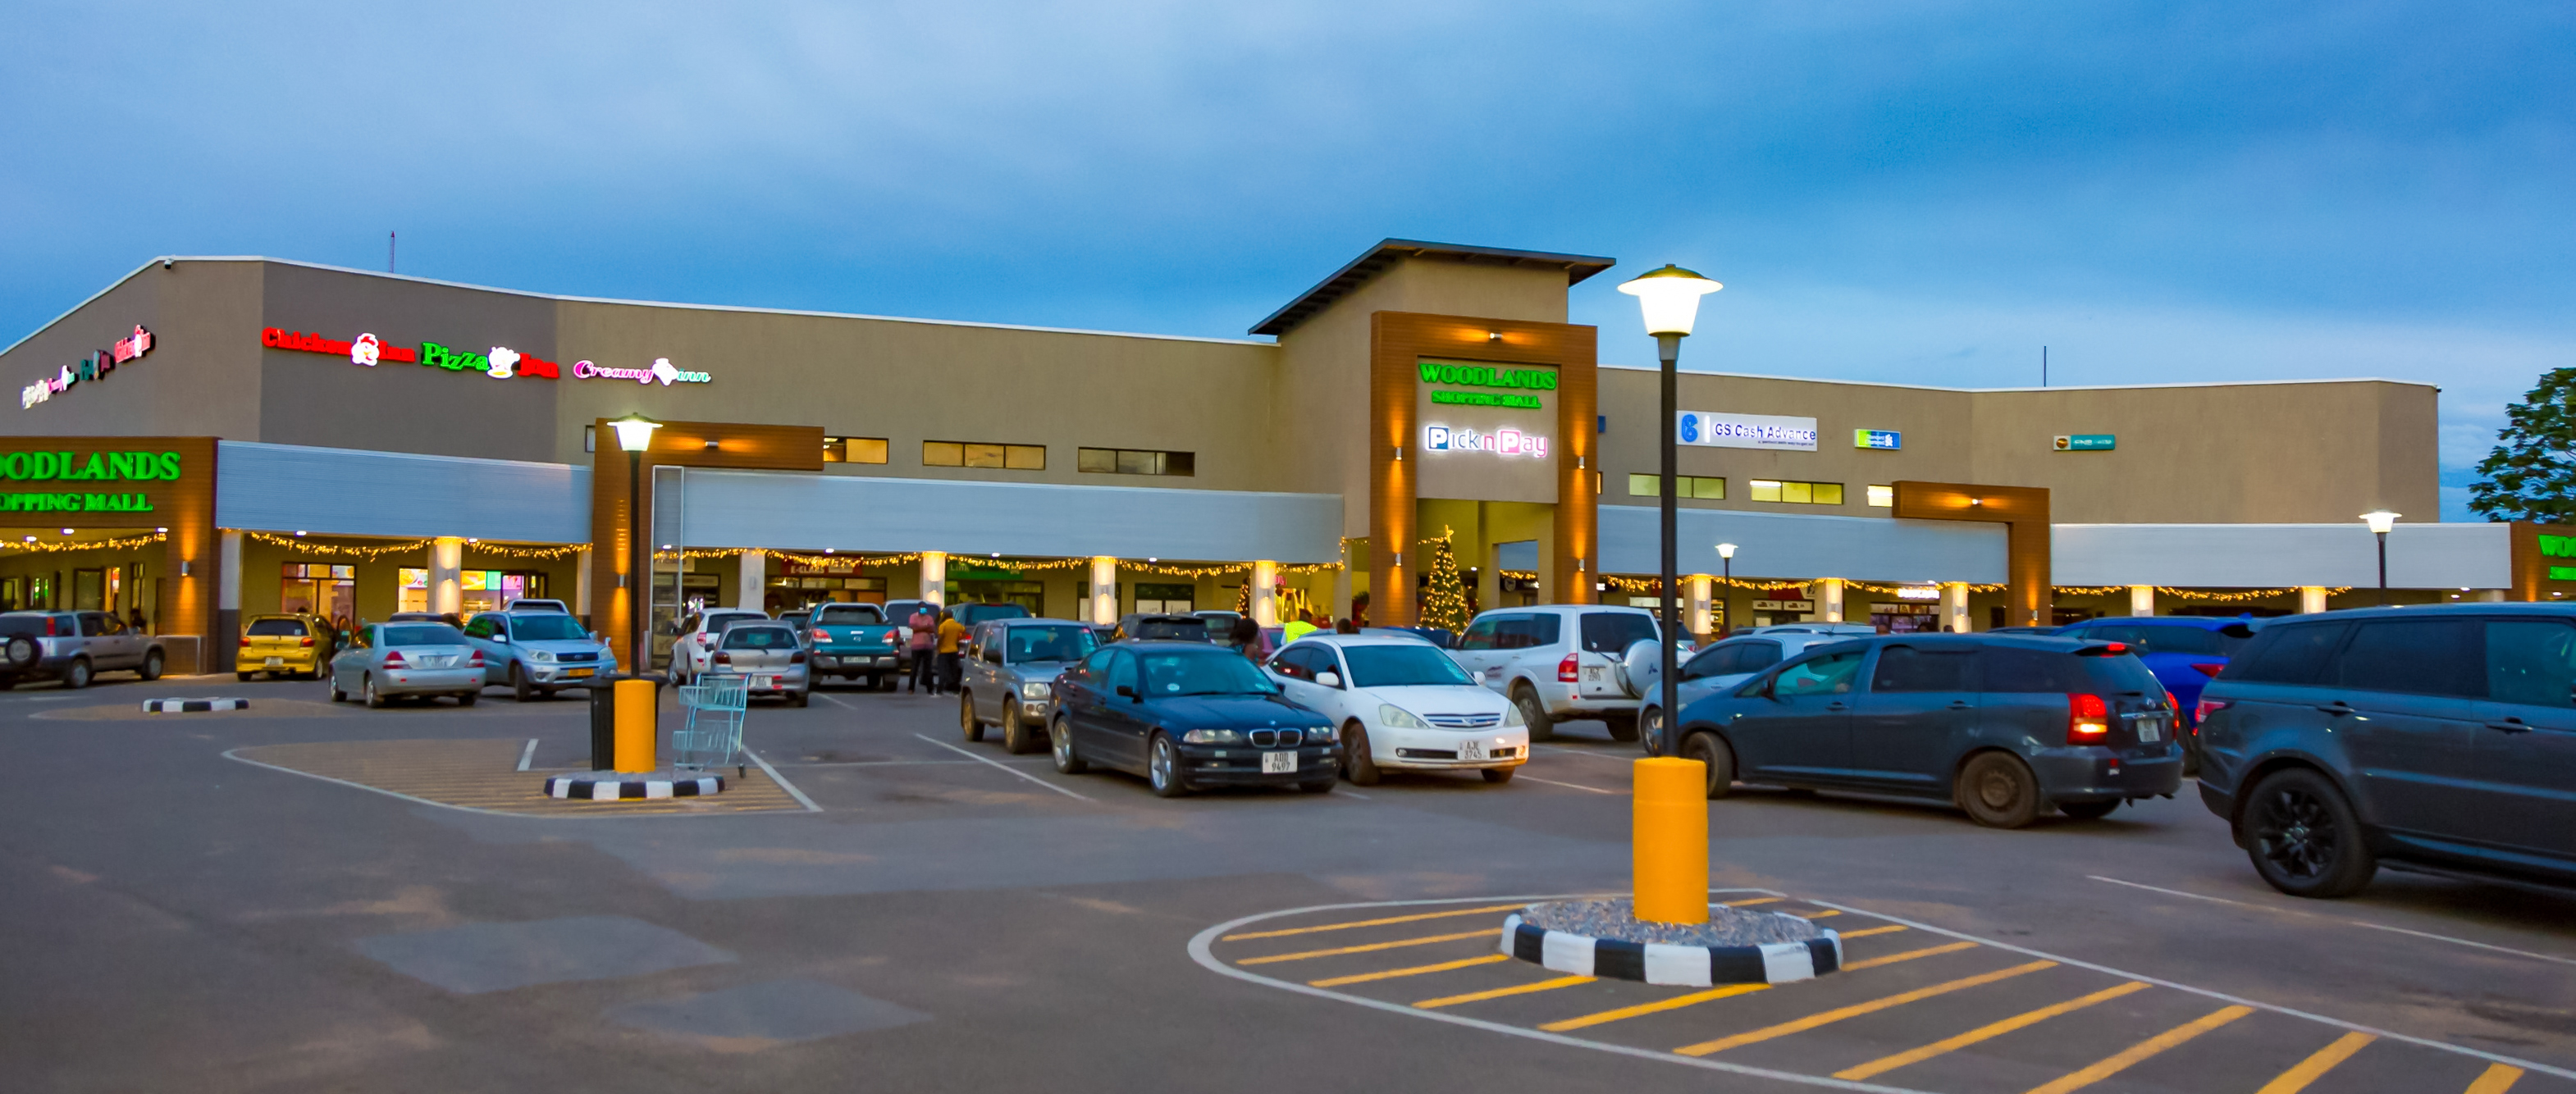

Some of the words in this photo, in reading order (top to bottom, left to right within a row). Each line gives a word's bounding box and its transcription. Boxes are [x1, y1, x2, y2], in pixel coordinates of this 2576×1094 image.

[262, 326, 352, 356] Chicken
[377, 340, 416, 362] Inn
[422, 341, 491, 371] Pizza
[518, 352, 560, 378] Inn
[573, 360, 654, 384] Creamy
[677, 368, 711, 382] inn
[1418, 363, 1557, 390] WOODLANDS
[1432, 390, 1501, 406] SHOPPING
[1502, 394, 1541, 408] MALL
[1715, 423, 1731, 435] GS
[1735, 425, 1763, 438] Cash
[1767, 426, 1816, 440] Advance
[0, 451, 180, 481] ODLANDS
[84, 493, 153, 511] MALL
